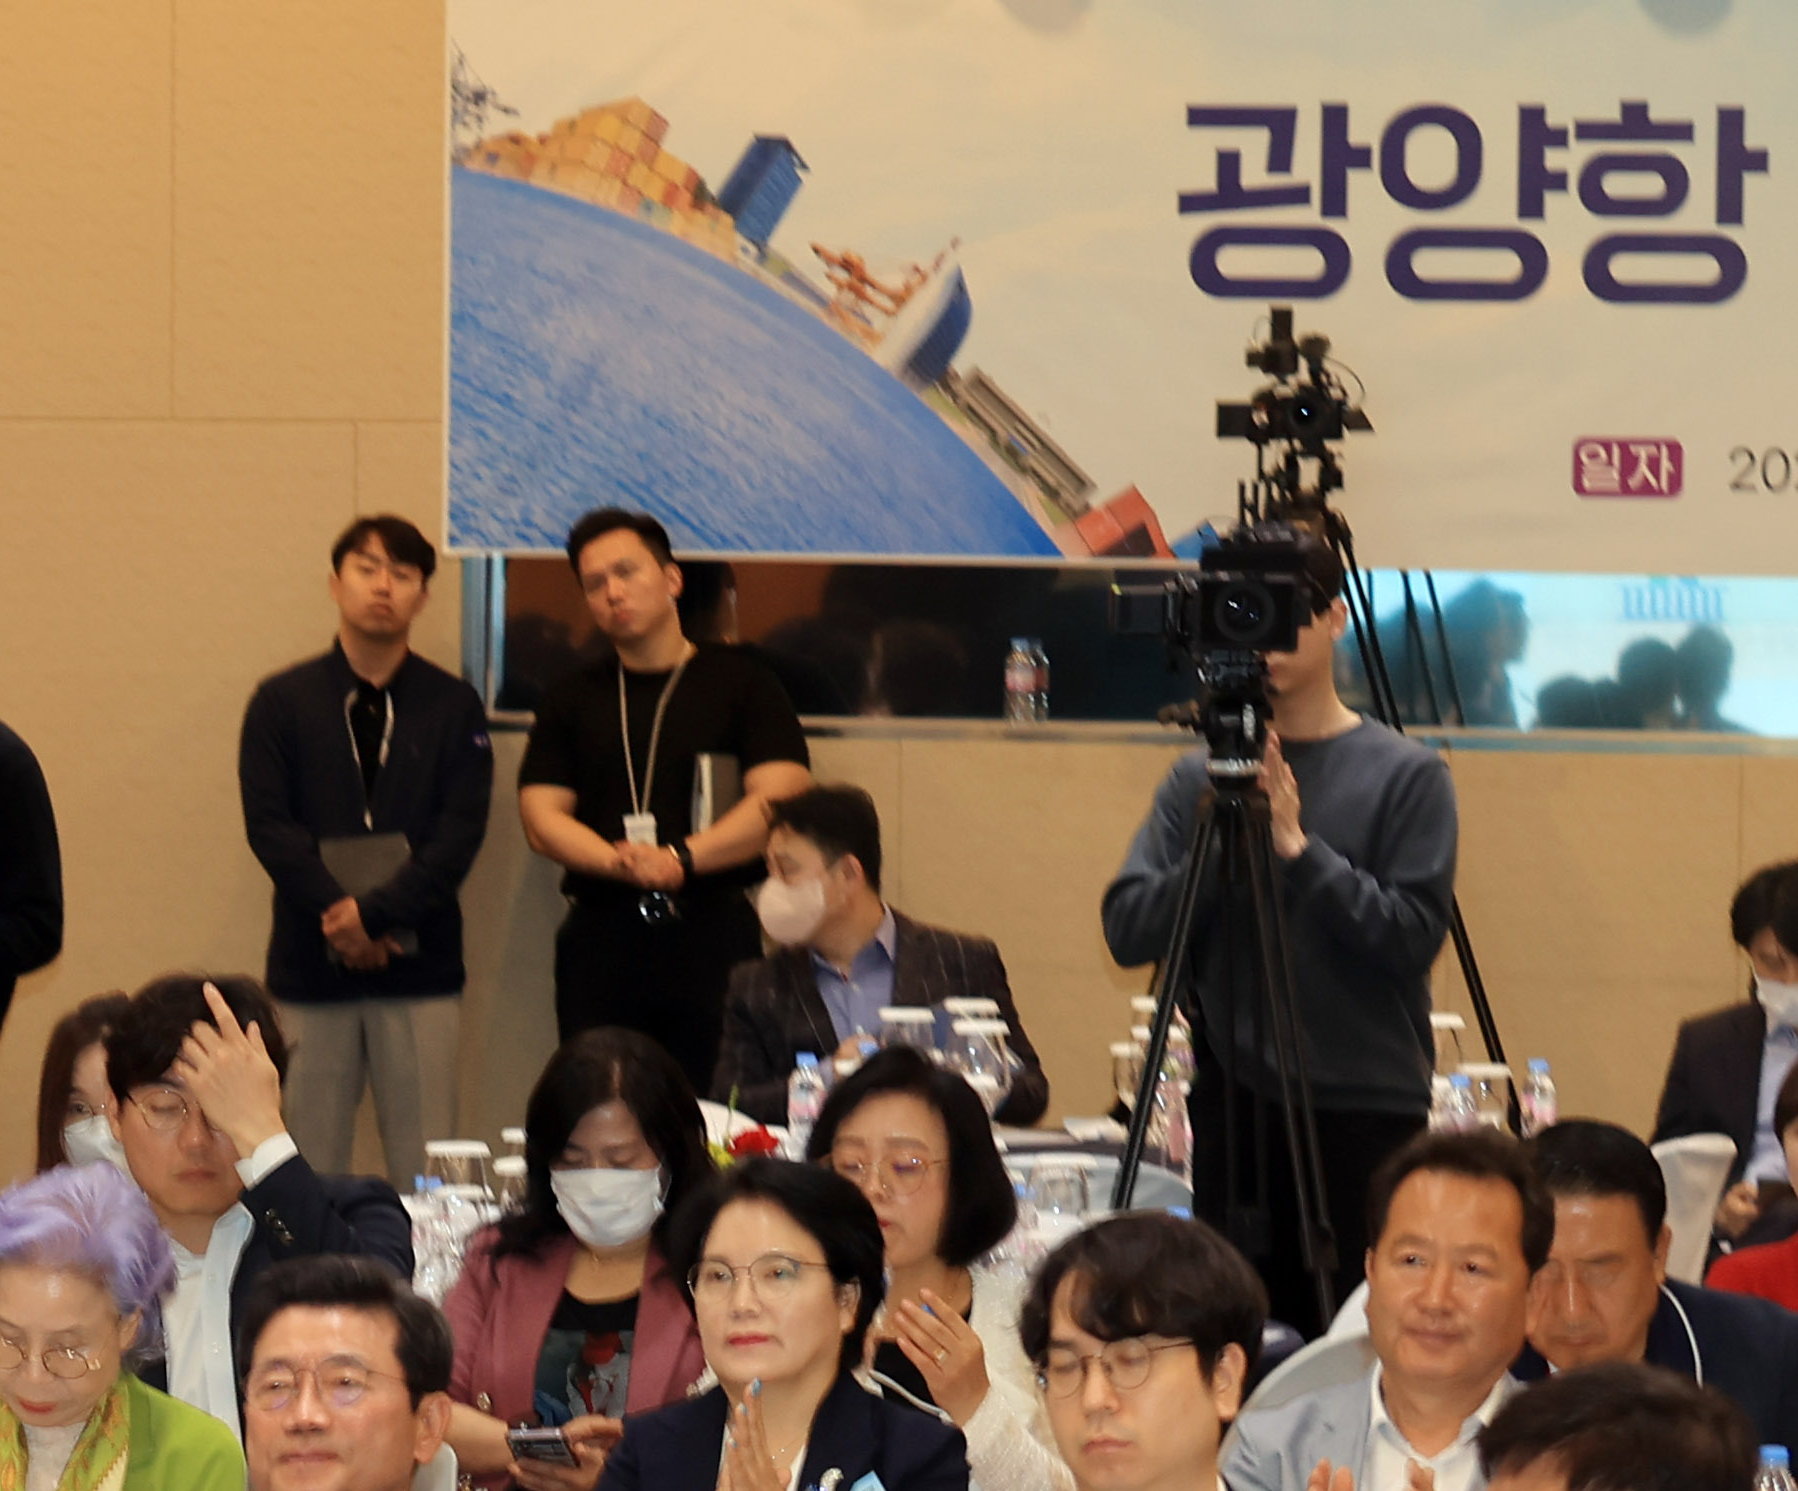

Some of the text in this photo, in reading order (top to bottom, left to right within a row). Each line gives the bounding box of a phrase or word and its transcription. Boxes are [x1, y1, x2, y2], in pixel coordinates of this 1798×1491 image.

[1177, 99, 1770, 305] 광양항
[1577, 442, 1676, 495] 일자
[1727, 446, 1798, 494] 20
